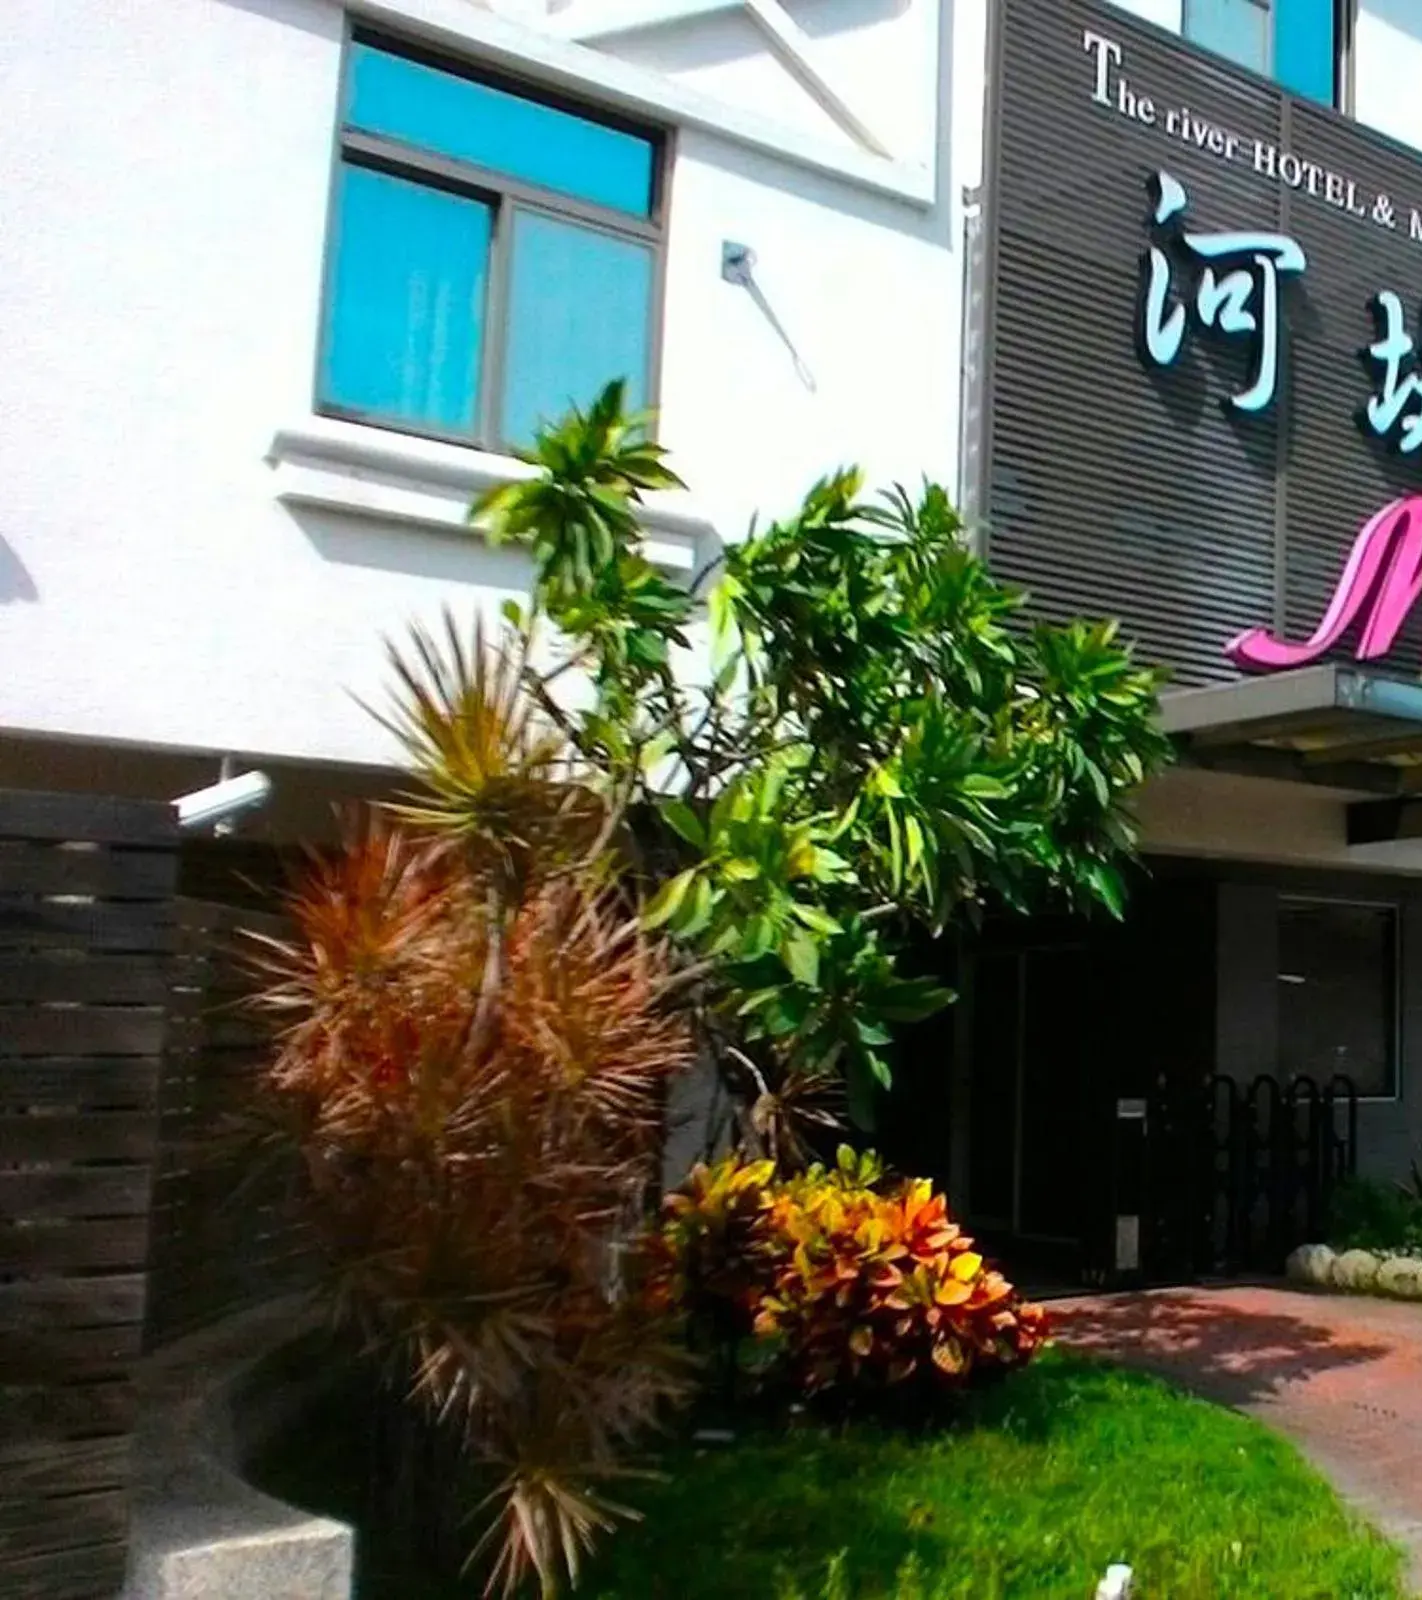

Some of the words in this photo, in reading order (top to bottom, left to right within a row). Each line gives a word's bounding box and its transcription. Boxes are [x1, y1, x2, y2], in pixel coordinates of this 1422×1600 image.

[1083, 30, 1157, 126] The
[1165, 107, 1239, 161] river
[1252, 141, 1367, 218] HOTEL
[1372, 194, 1397, 229] &
